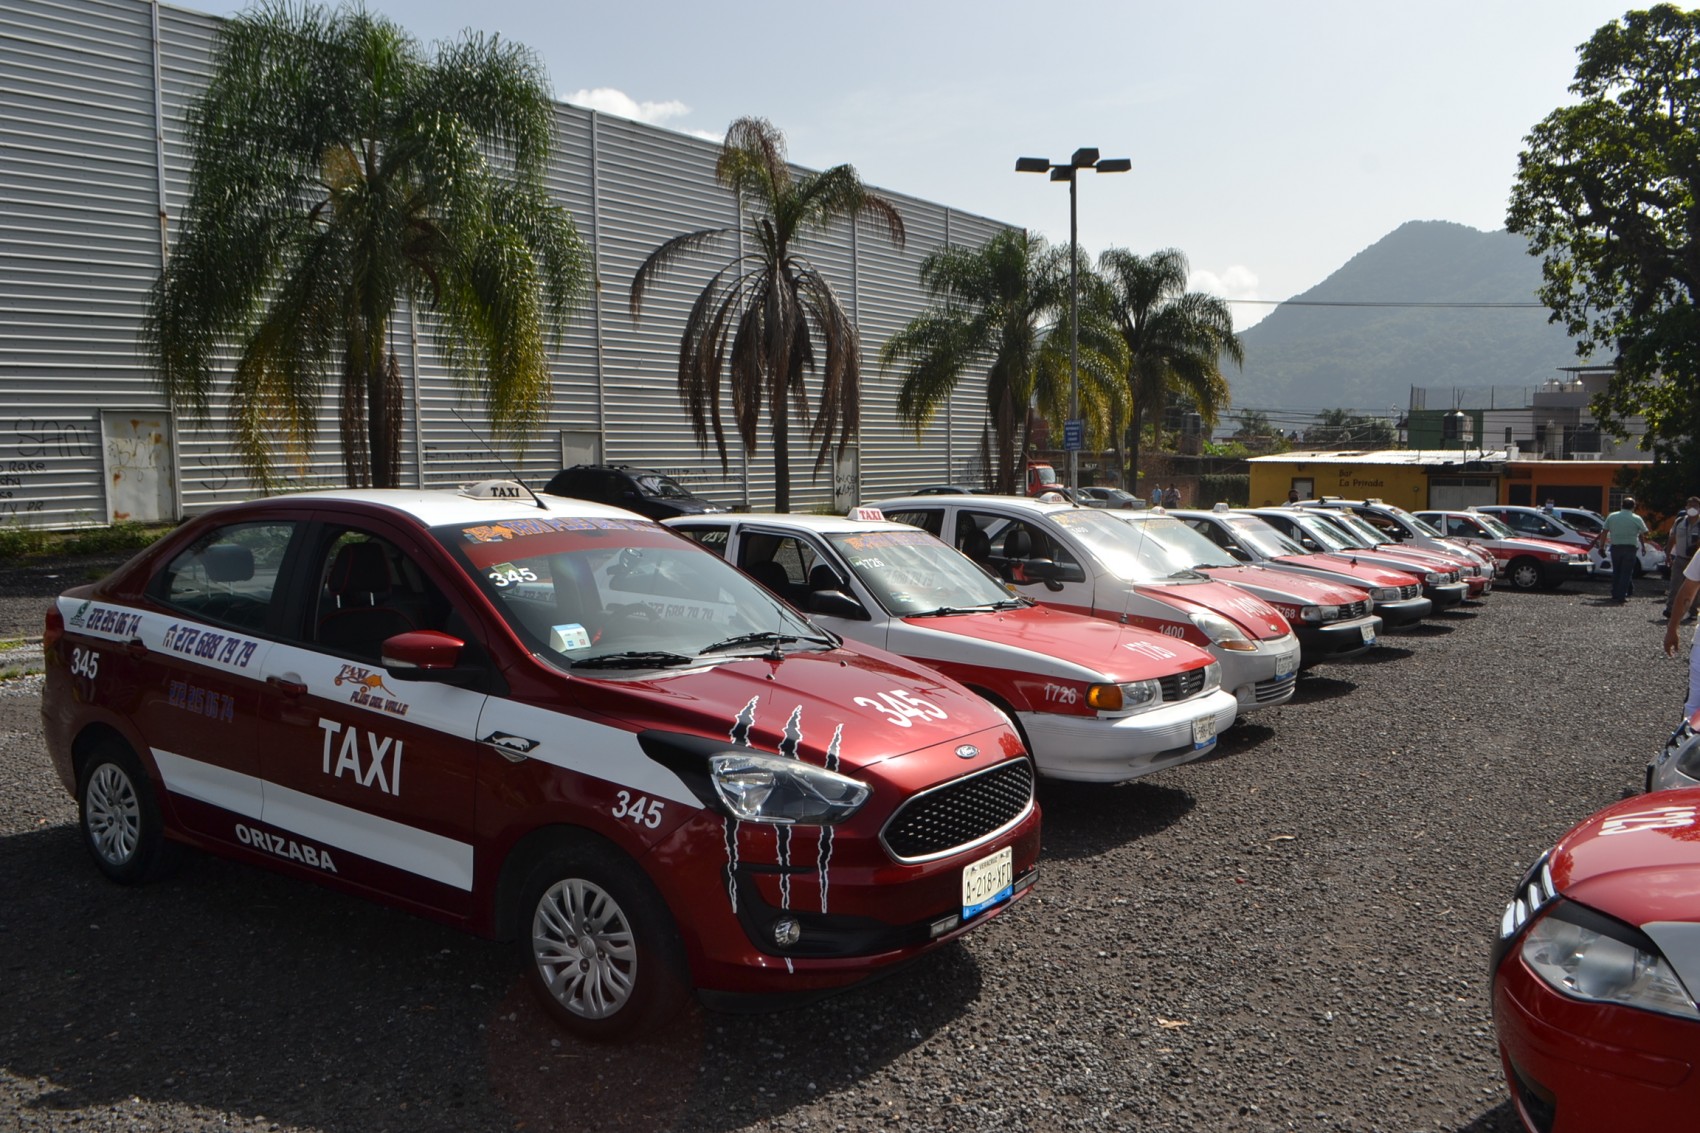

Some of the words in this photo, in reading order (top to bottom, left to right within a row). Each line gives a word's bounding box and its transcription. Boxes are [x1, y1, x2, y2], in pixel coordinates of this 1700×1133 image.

[1338, 469, 1352, 477] Bar
[1338, 478, 1350, 487] La
[1353, 478, 1384, 488] Privada
[491, 487, 520, 498] TAXI
[859, 510, 881, 521] TAXI
[489, 567, 538, 587] 345
[86, 608, 106, 631] 272
[126, 614, 143, 637] 74
[1158, 624, 1185, 639] 1400
[173, 627, 201, 654] 272
[195, 632, 223, 660] 688
[217, 637, 240, 664] 79
[233, 641, 259, 668] 79
[71, 647, 100, 680] 345
[340, 664, 371, 680] TAXI
[1043, 683, 1077, 705] 1726
[384, 699, 409, 716] VALLE
[853, 689, 948, 728] 345
[318, 717, 404, 796] TAXI
[611, 790, 665, 829] 345
[235, 823, 338, 873] ORIZABA
[966, 861, 1011, 903] A-218-XFD
